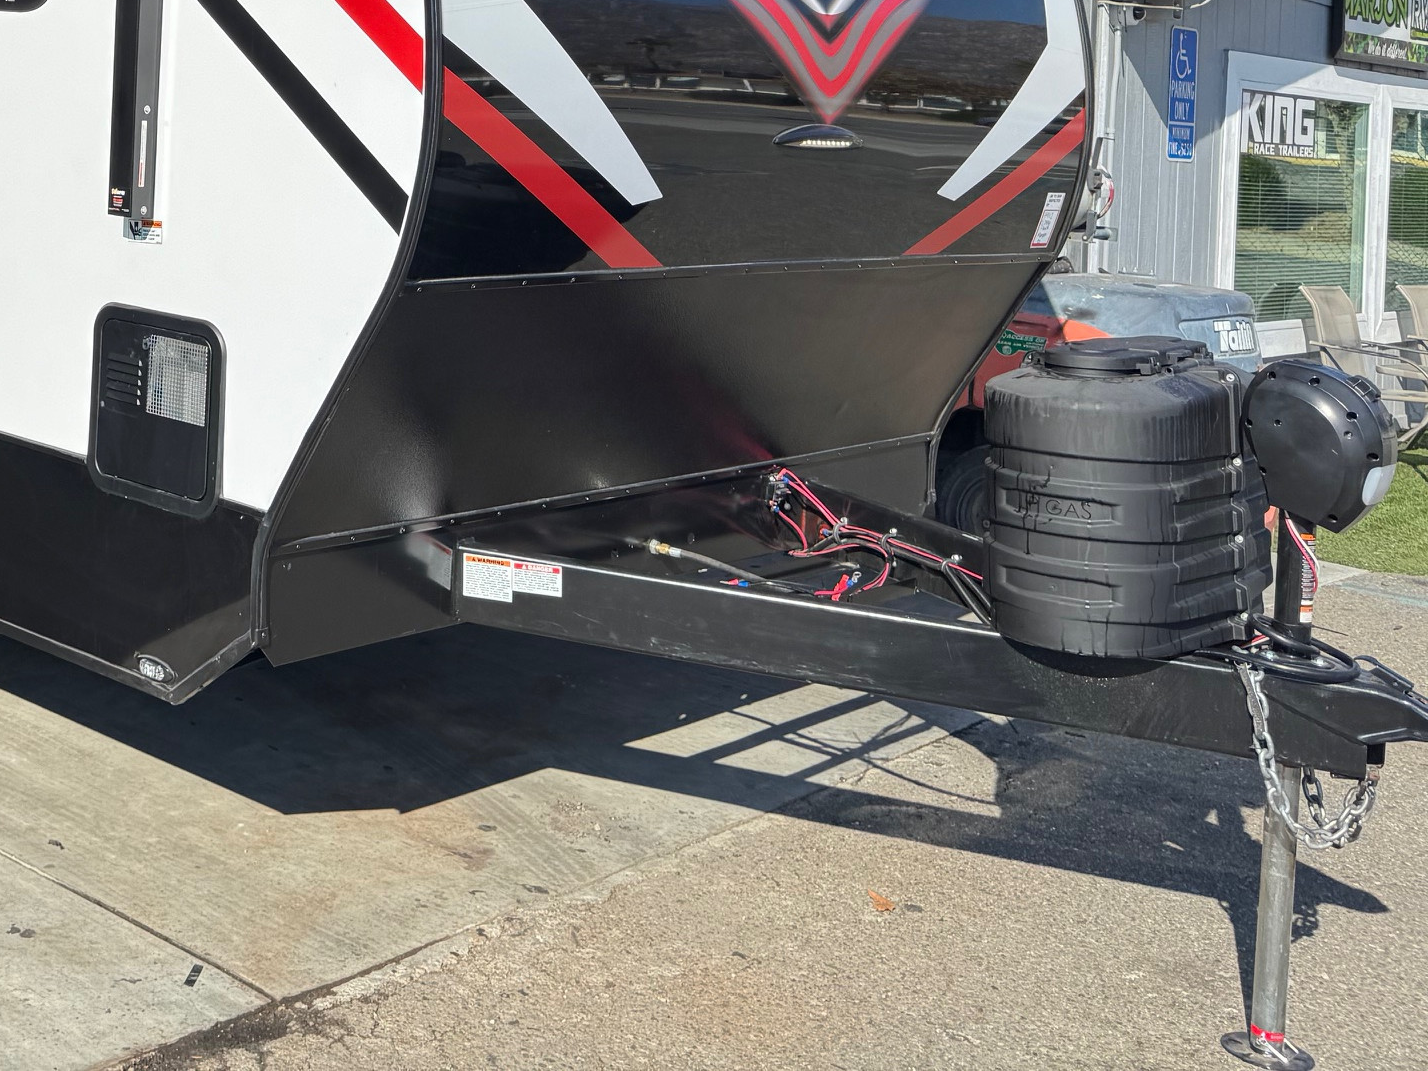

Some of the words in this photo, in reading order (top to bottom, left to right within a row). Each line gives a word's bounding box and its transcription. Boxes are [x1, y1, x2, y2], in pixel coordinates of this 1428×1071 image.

[1171, 80, 1195, 100] PARKING
[1174, 101, 1190, 120] ONLY
[1241, 91, 1316, 153] KING
[1254, 143, 1276, 156] RACE
[1278, 144, 1314, 158] TRAILERS
[1045, 499, 1093, 520] GAS
